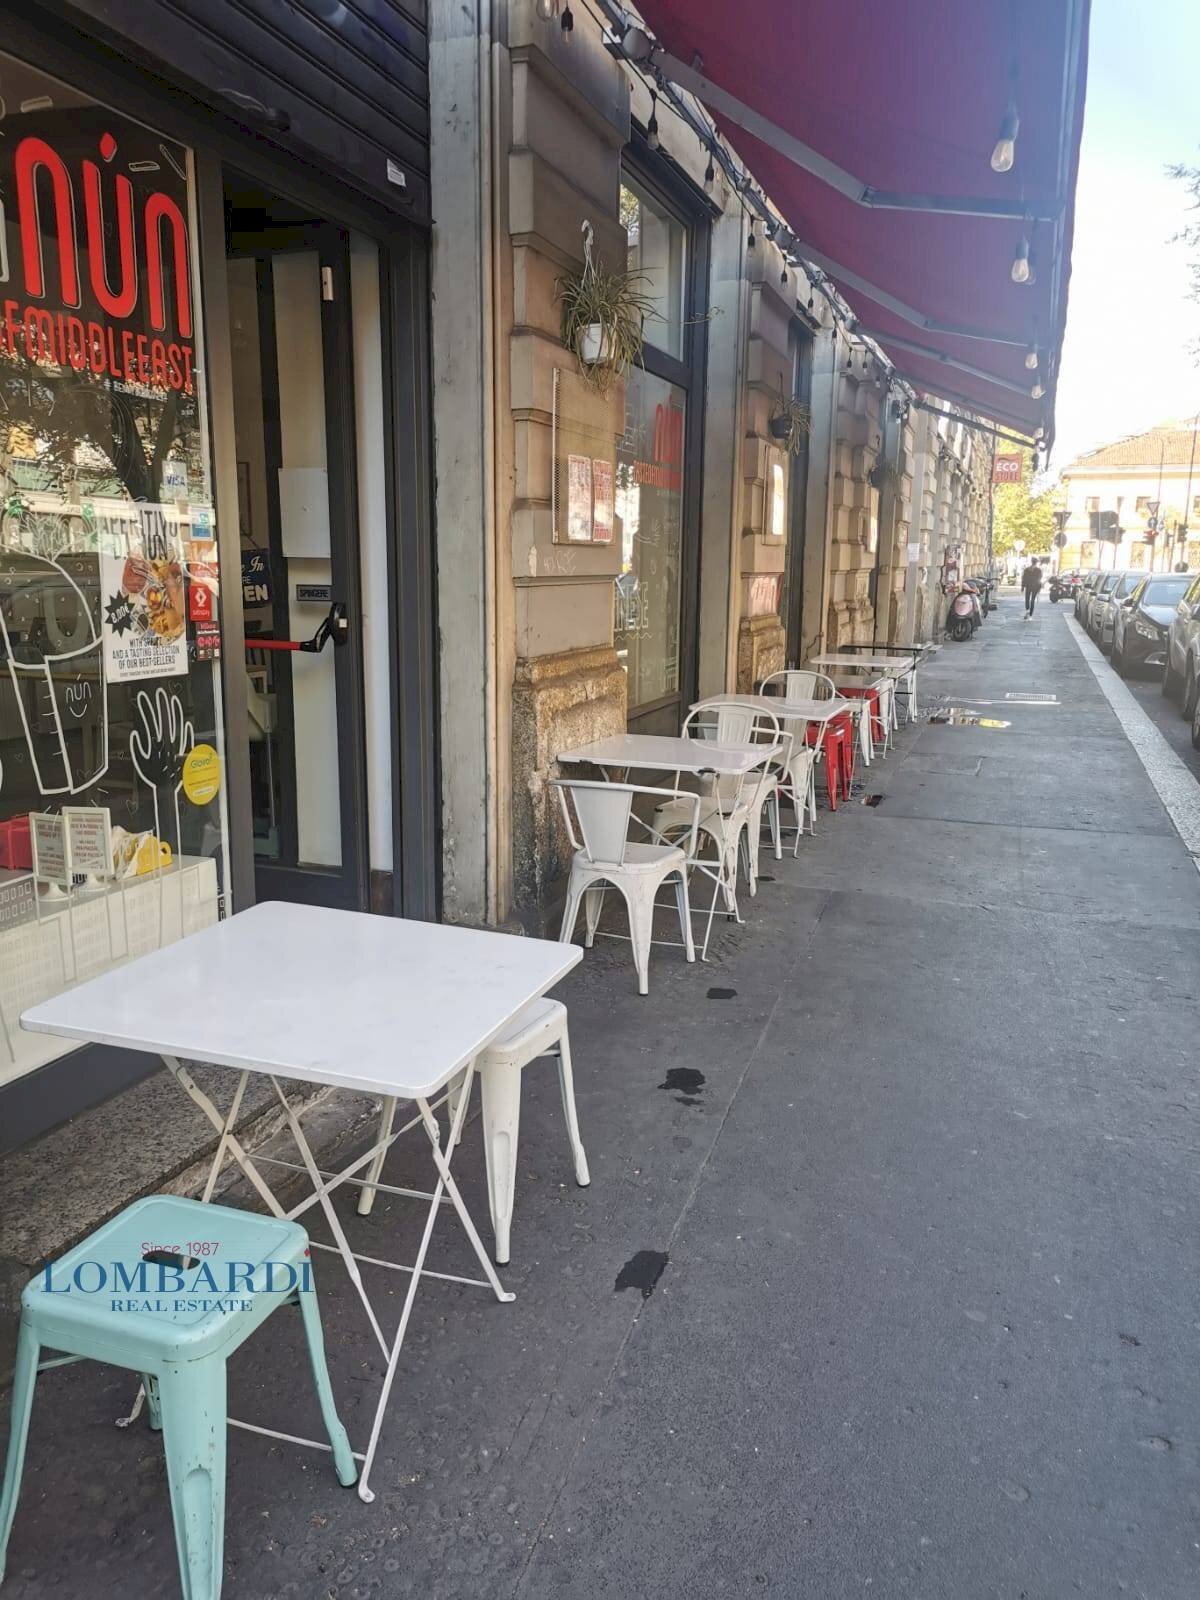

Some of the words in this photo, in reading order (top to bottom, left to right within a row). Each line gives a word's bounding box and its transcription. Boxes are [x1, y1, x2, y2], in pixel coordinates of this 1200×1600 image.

[996, 462, 1018, 472] ECO
[166, 475, 186, 487] VISA
[249, 556, 265, 573] In
[243, 583, 269, 602] EN
[129, 638, 143, 648] WITH
[112, 648, 124, 660] AND
[130, 646, 152, 659] TASTING
[153, 644, 180, 657] SELECTION
[118, 659, 126, 670] OF
[126, 658, 139, 669] OUR
